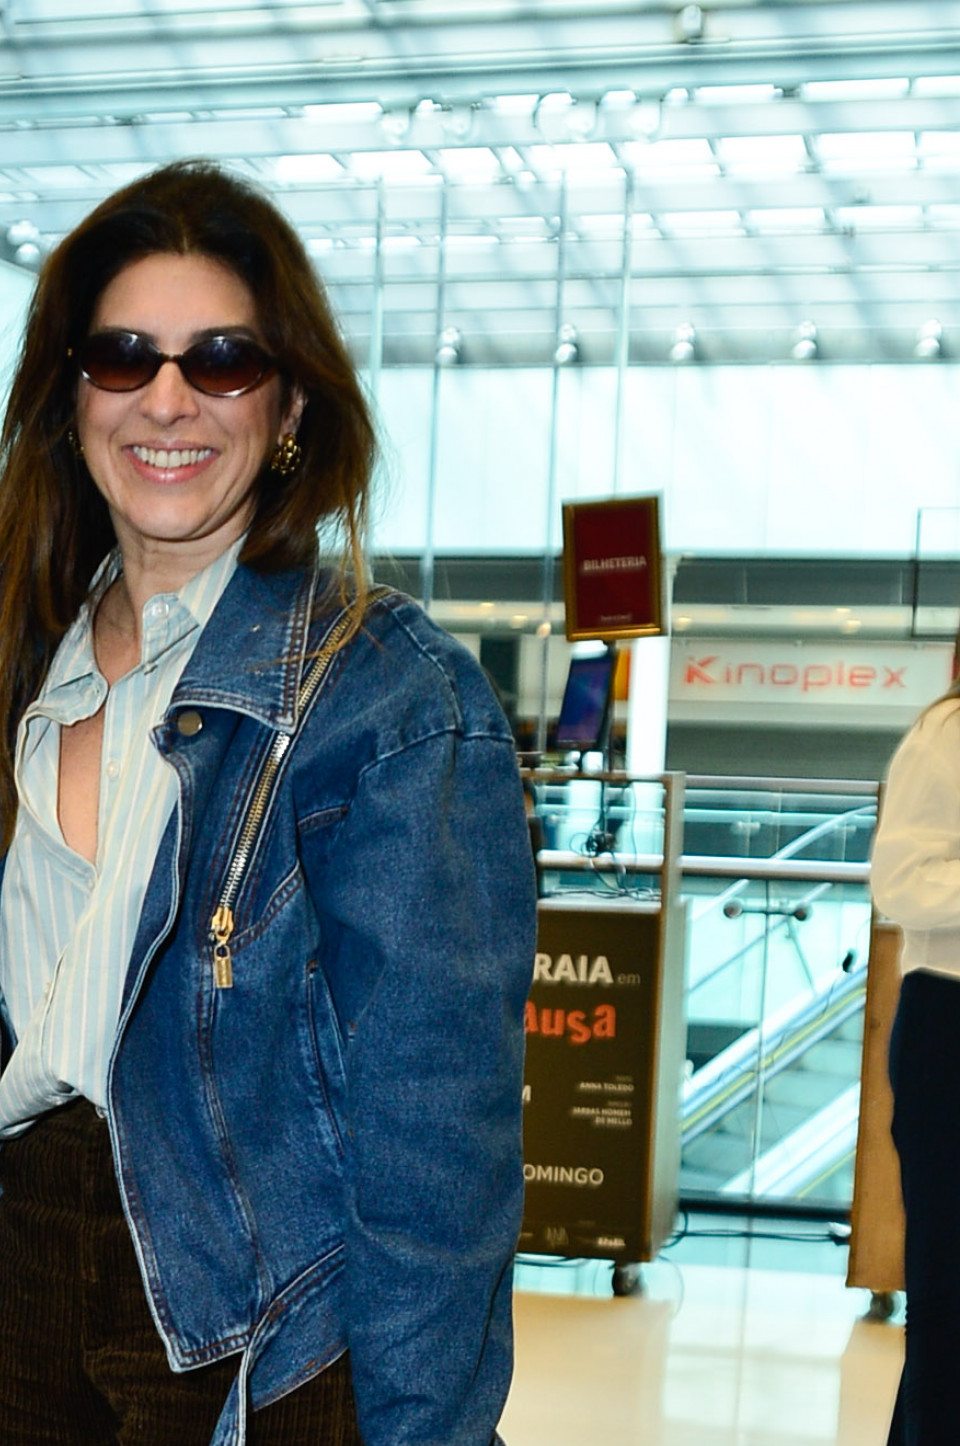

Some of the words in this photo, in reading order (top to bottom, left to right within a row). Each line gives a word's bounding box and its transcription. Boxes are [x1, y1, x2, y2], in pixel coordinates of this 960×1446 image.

[583, 556, 647, 571] BILHETERIA
[685, 655, 909, 693] Kinoplex
[533, 952, 614, 984] RAIA
[617, 973, 641, 985] em
[523, 1163, 605, 1186] OMINGO
